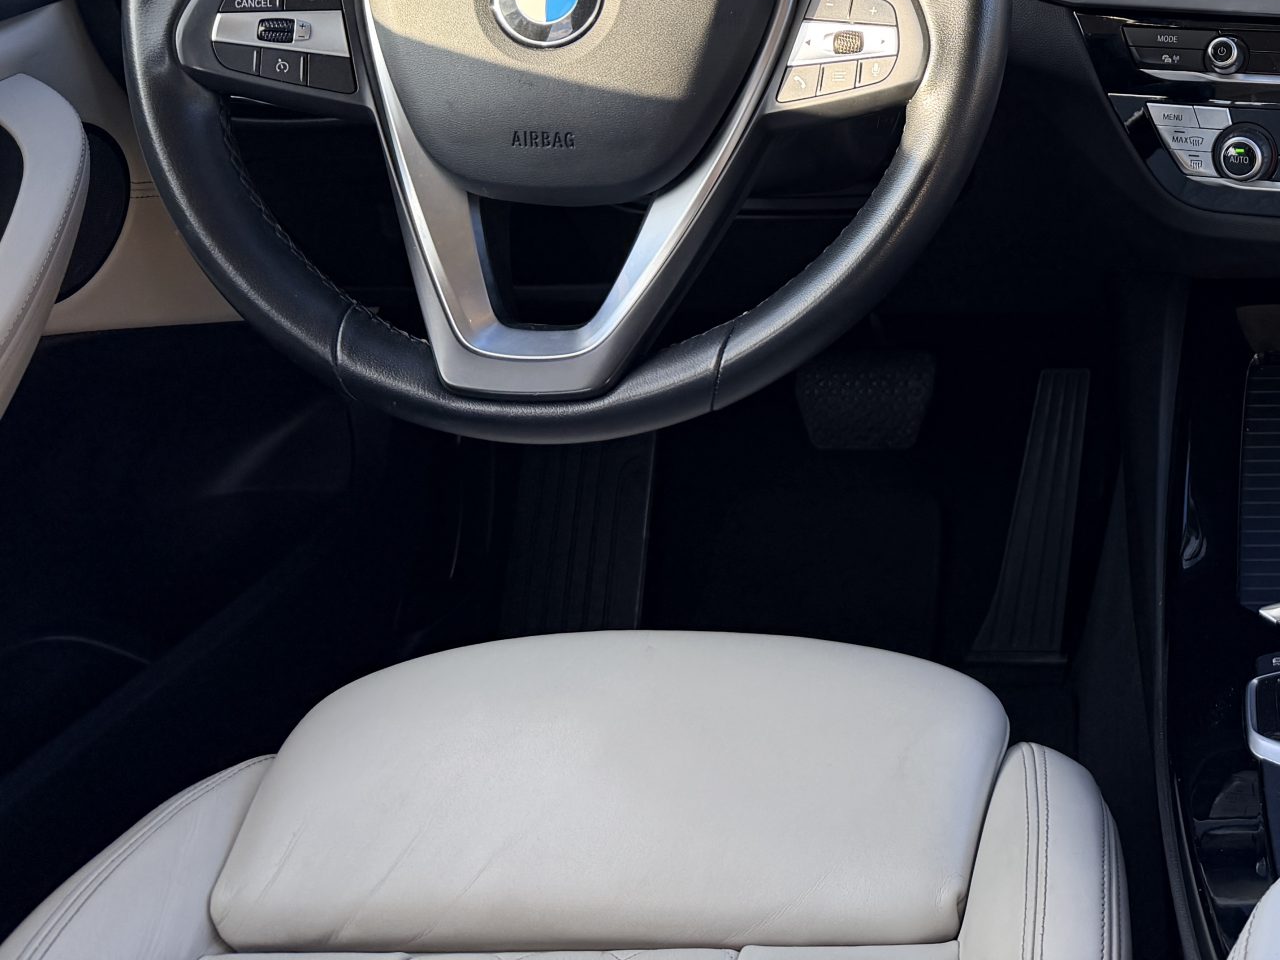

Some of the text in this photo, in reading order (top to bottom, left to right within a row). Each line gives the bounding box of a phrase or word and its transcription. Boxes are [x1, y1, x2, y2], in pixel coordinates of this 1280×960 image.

[234, 0, 273, 9] CANCEL
[1157, 34, 1178, 43] MODE
[1162, 113, 1183, 121] MENU
[511, 130, 576, 149] AIRBAG
[1171, 136, 1189, 144] MAX
[1229, 156, 1249, 164] AUTO
